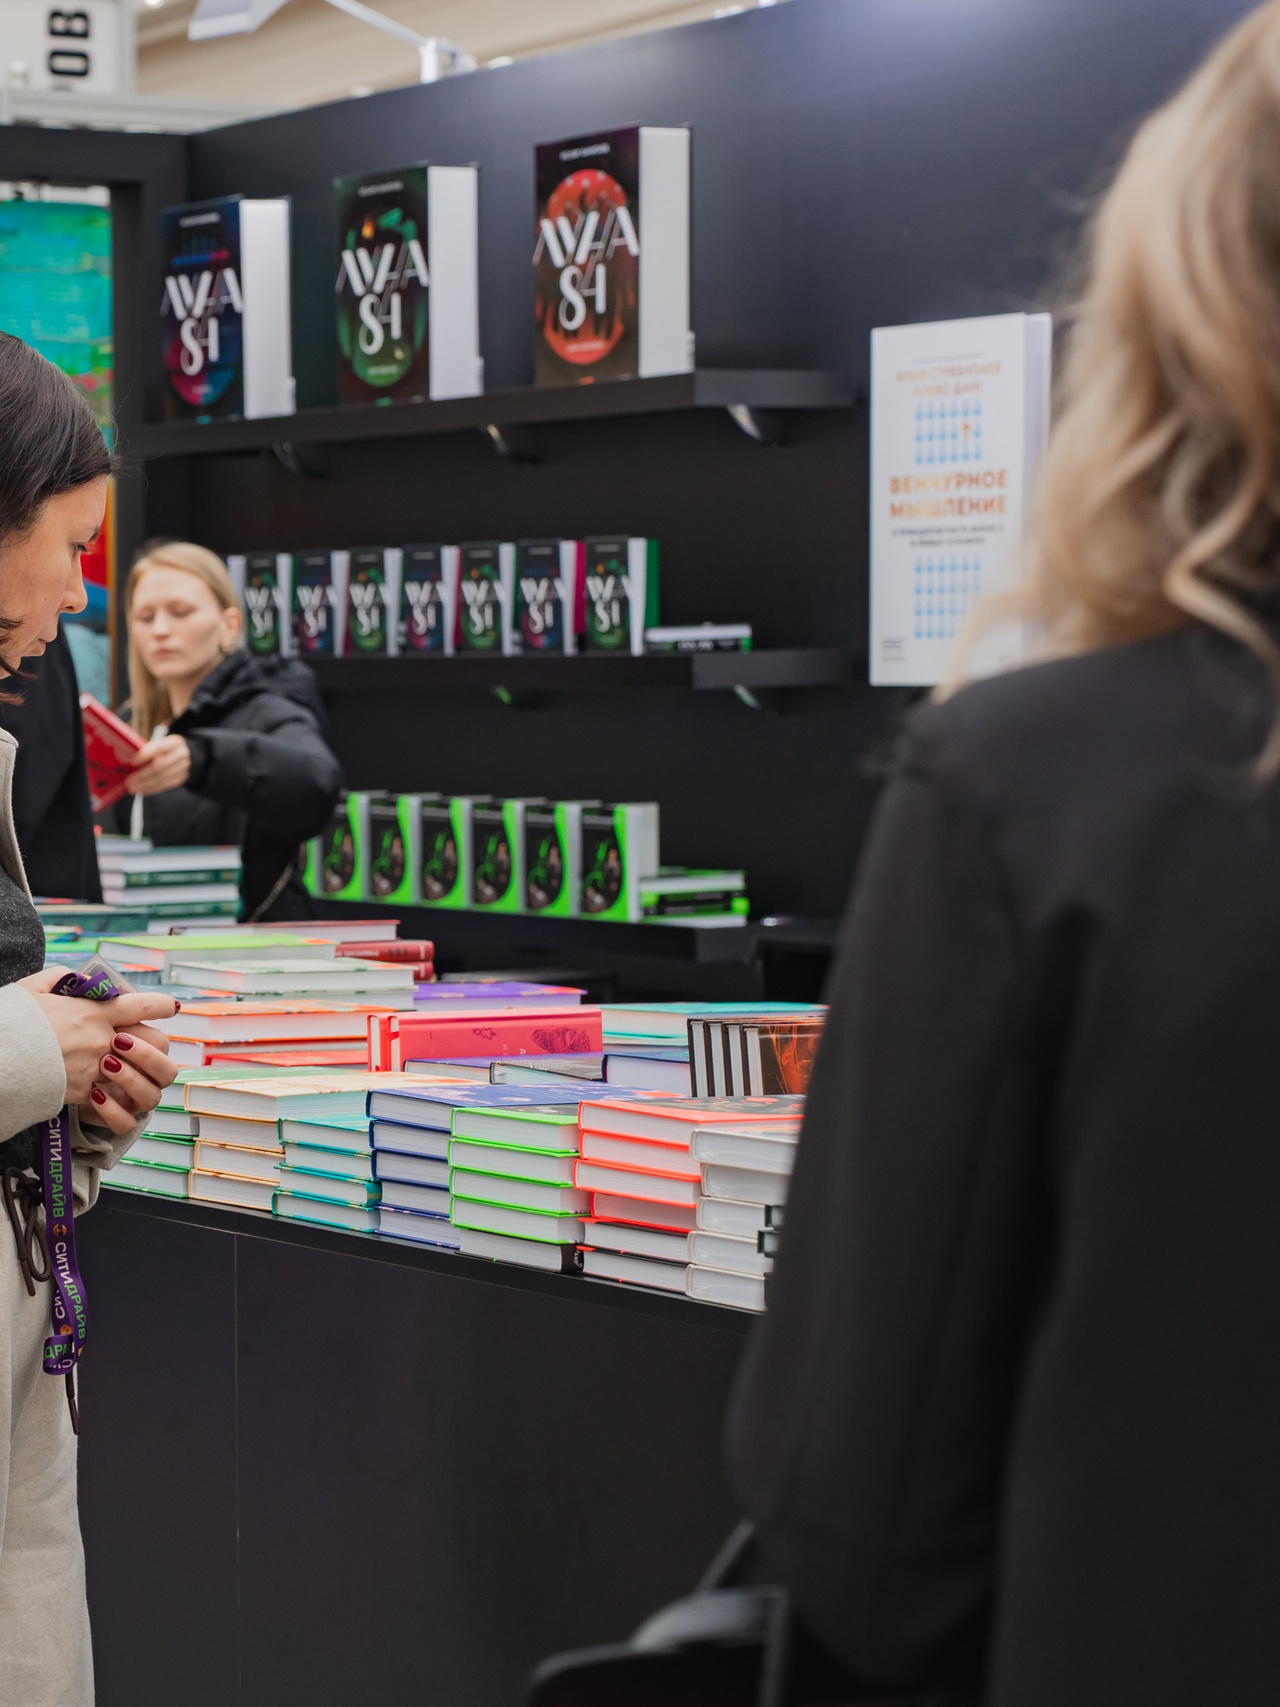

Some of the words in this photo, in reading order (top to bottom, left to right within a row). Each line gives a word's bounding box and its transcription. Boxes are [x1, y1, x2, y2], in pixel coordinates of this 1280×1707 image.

[889, 469, 1008, 495] ВЕНЧУРНОЕ
[889, 495, 1008, 519] МЫШЛЕНИЕ
[54, 1241, 87, 1340] СИТИДРАЙВ
